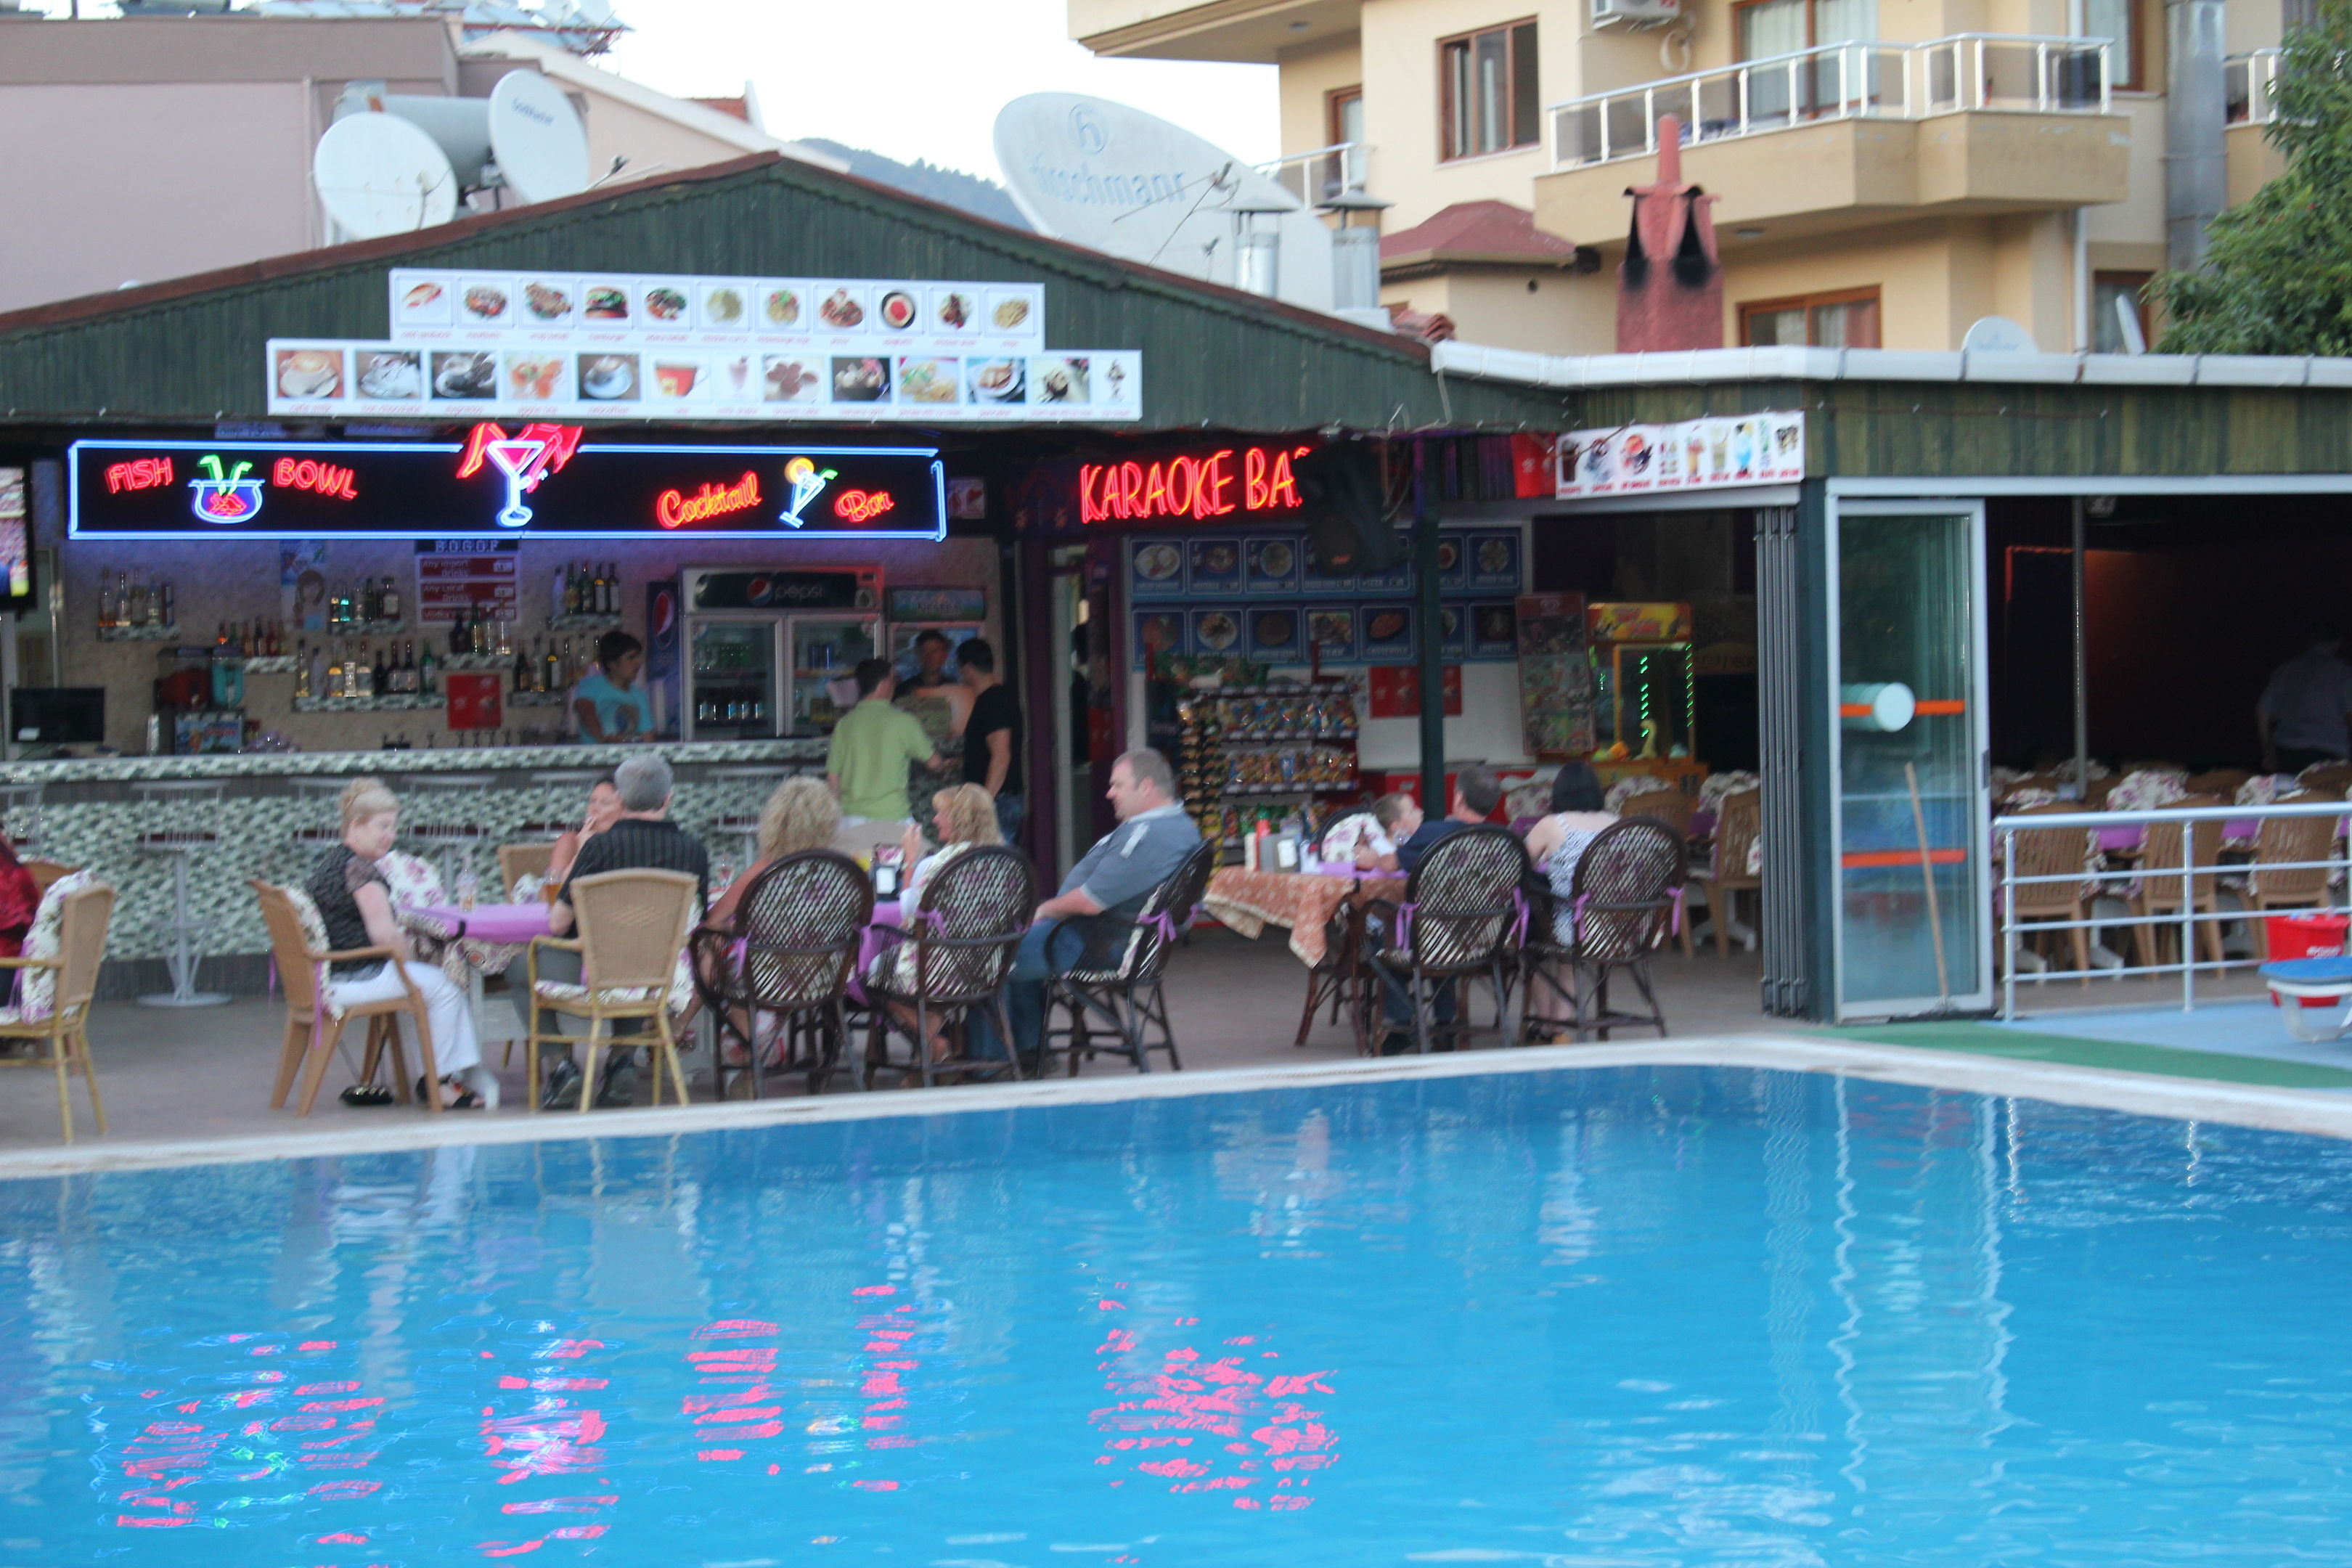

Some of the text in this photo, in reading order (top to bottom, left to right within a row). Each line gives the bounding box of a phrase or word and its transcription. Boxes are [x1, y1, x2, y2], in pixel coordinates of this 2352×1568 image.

[105, 457, 359, 501] FISH BOWL
[1080, 449, 1236, 524] KARAOKE
[656, 470, 894, 530] Cocktail Bar
[422, 560, 439, 570] Any
[441, 559, 468, 569] Import
[441, 569, 469, 578] Drinks
[423, 584, 440, 594] Any
[441, 584, 465, 592] Local
[775, 582, 824, 601] pepsi
[442, 593, 469, 603] Drinks
